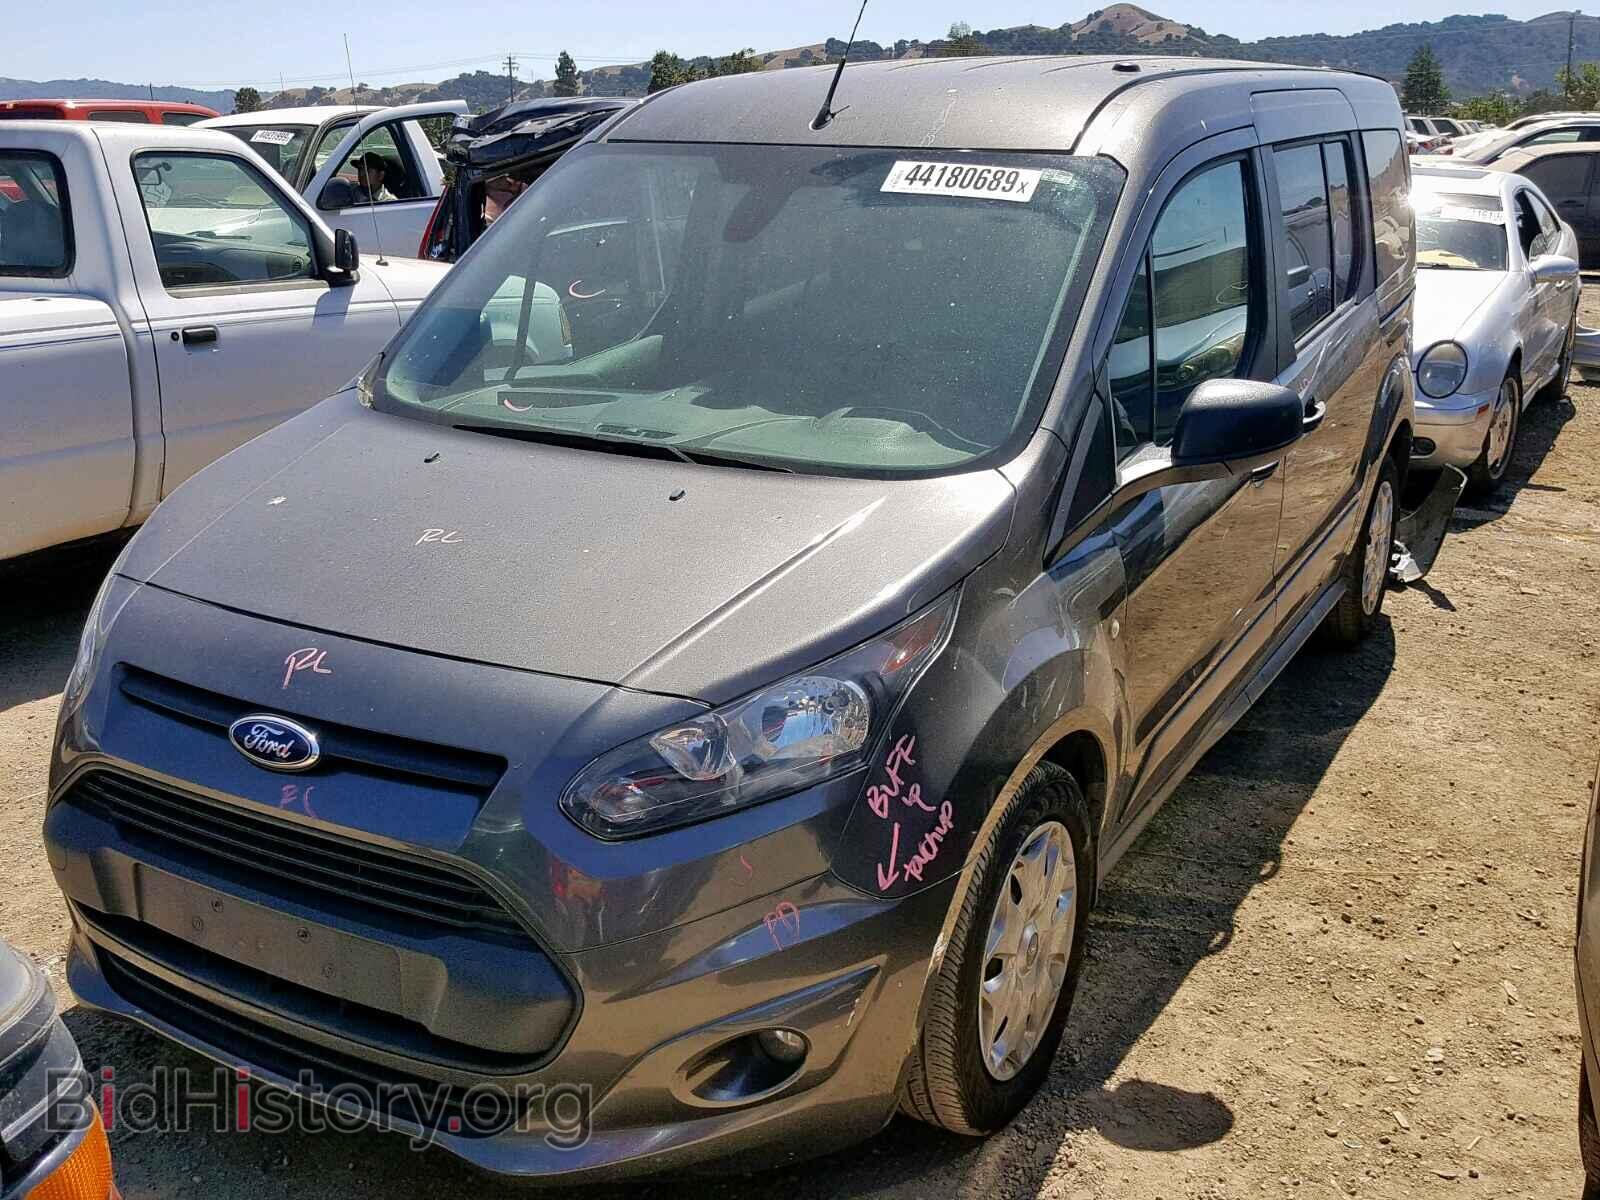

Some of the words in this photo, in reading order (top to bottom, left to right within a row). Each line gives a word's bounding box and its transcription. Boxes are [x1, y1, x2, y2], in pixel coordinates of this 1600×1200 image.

[905, 165, 1020, 192] 44180689
[243, 723, 295, 759] Ford
[866, 734, 916, 818] BUFF
